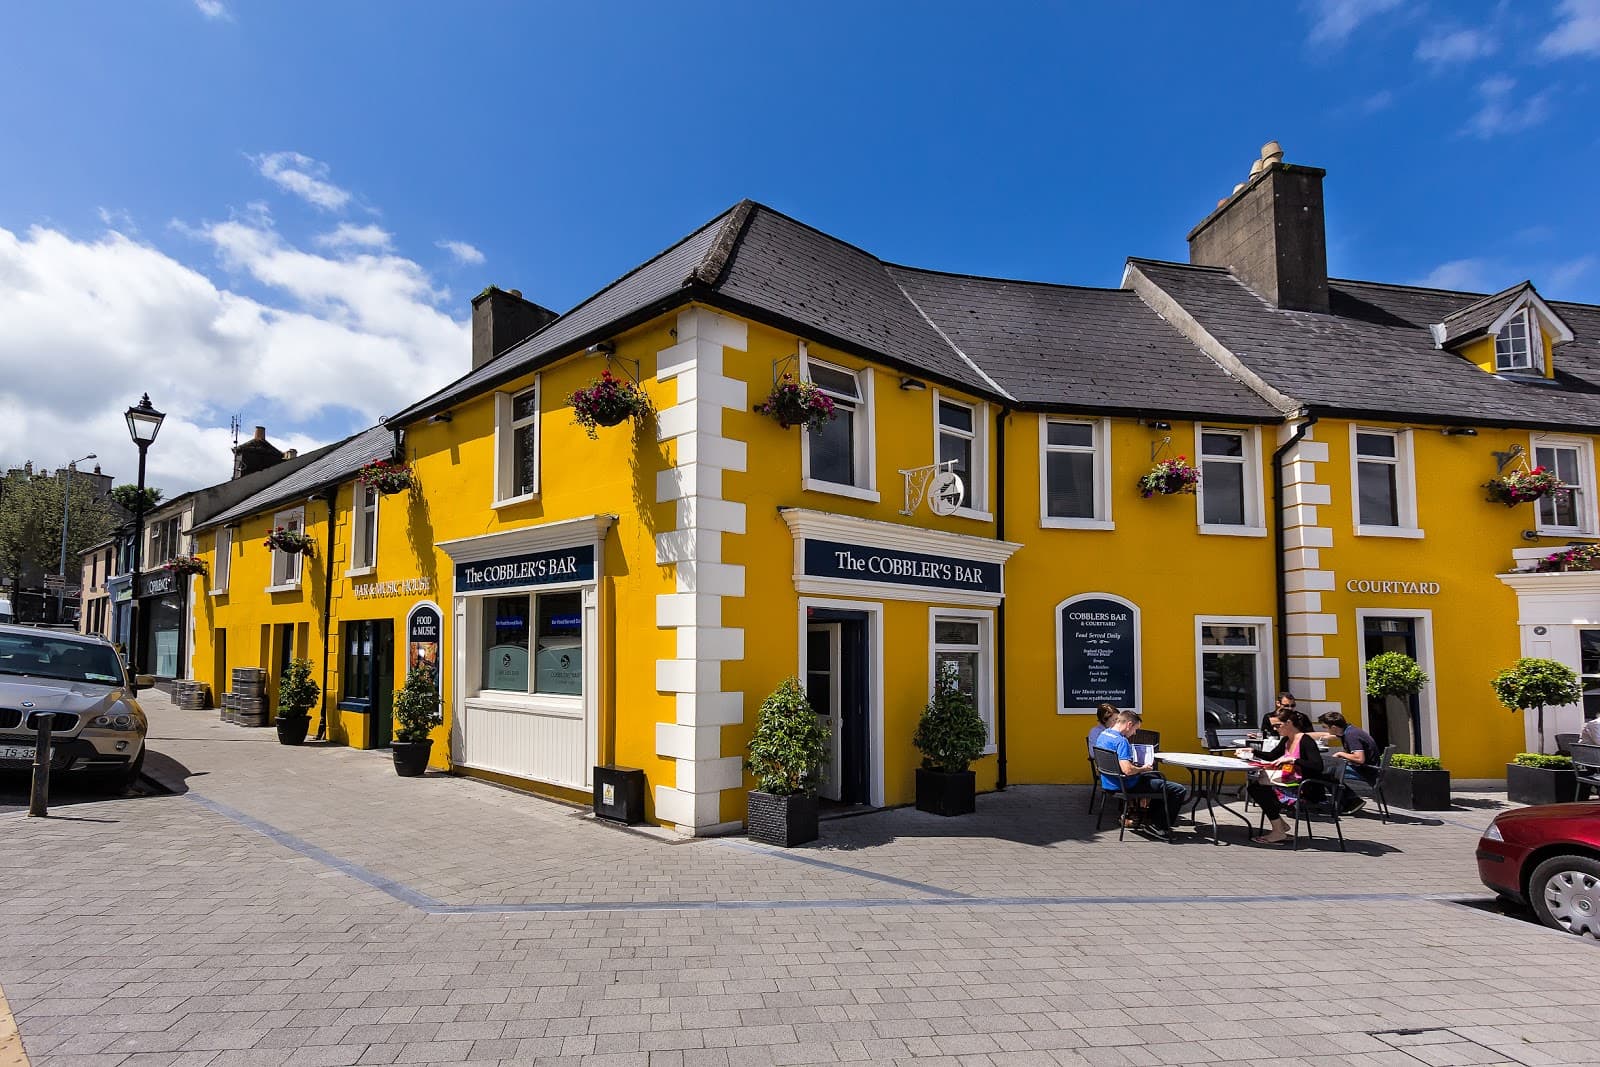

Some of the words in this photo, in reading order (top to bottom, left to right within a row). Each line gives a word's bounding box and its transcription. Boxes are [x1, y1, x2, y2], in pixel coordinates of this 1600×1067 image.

[464, 567, 483, 583] The
[483, 559, 546, 582] COBBLER'S
[549, 555, 577, 574] BAR
[835, 551, 866, 571] The
[868, 556, 951, 581] COBBLER'S
[954, 565, 984, 584] BAR
[354, 583, 369, 597] BAR
[375, 580, 400, 595] MUSIC
[401, 576, 431, 592] HOUSE
[1346, 579, 1440, 595] COURTYARD
[416, 615, 432, 625] FOOD
[1069, 612, 1109, 621] COBBLERS
[1110, 613, 1127, 621] BAR
[412, 628, 418, 636] &
[417, 625, 436, 636] MUSIC
